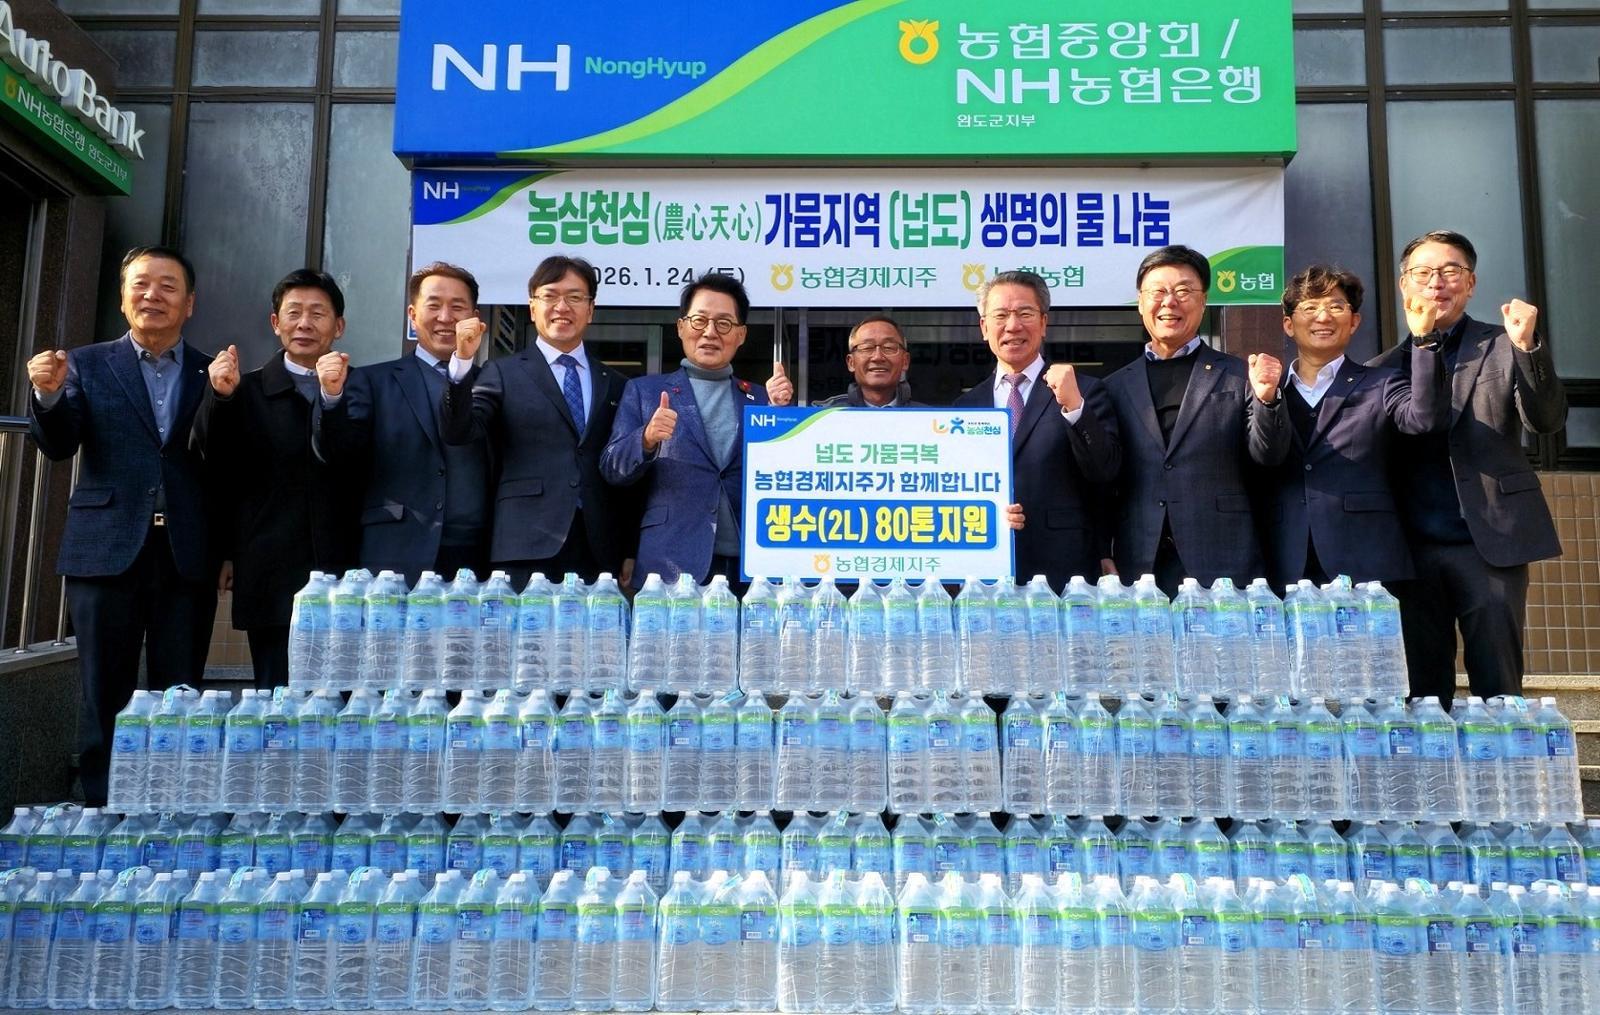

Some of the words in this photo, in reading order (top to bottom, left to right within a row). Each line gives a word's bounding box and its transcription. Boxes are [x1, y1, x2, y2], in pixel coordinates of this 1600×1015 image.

[957, 21, 1200, 60] 농협중앙회
[432, 44, 570, 91] NH
[585, 56, 706, 79] NongHyup
[423, 181, 459, 199] NH
[980, 192, 1067, 248] 생명의
[1076, 192, 1104, 247] 물
[1113, 192, 1171, 247] 나눔
[800, 266, 937, 289] 농협경제지주
[994, 265, 1084, 289] 농협
[1240, 272, 1275, 291] 농협
[750, 414, 776, 427] NH
[815, 443, 853, 464] 넙도
[860, 443, 939, 465] 가뭄극복
[754, 470, 895, 492] 농협경제지주가
[900, 471, 1001, 493] 함께합니다
[765, 504, 869, 543] 생수(2L)
[836, 556, 942, 573] 농협경제지주
